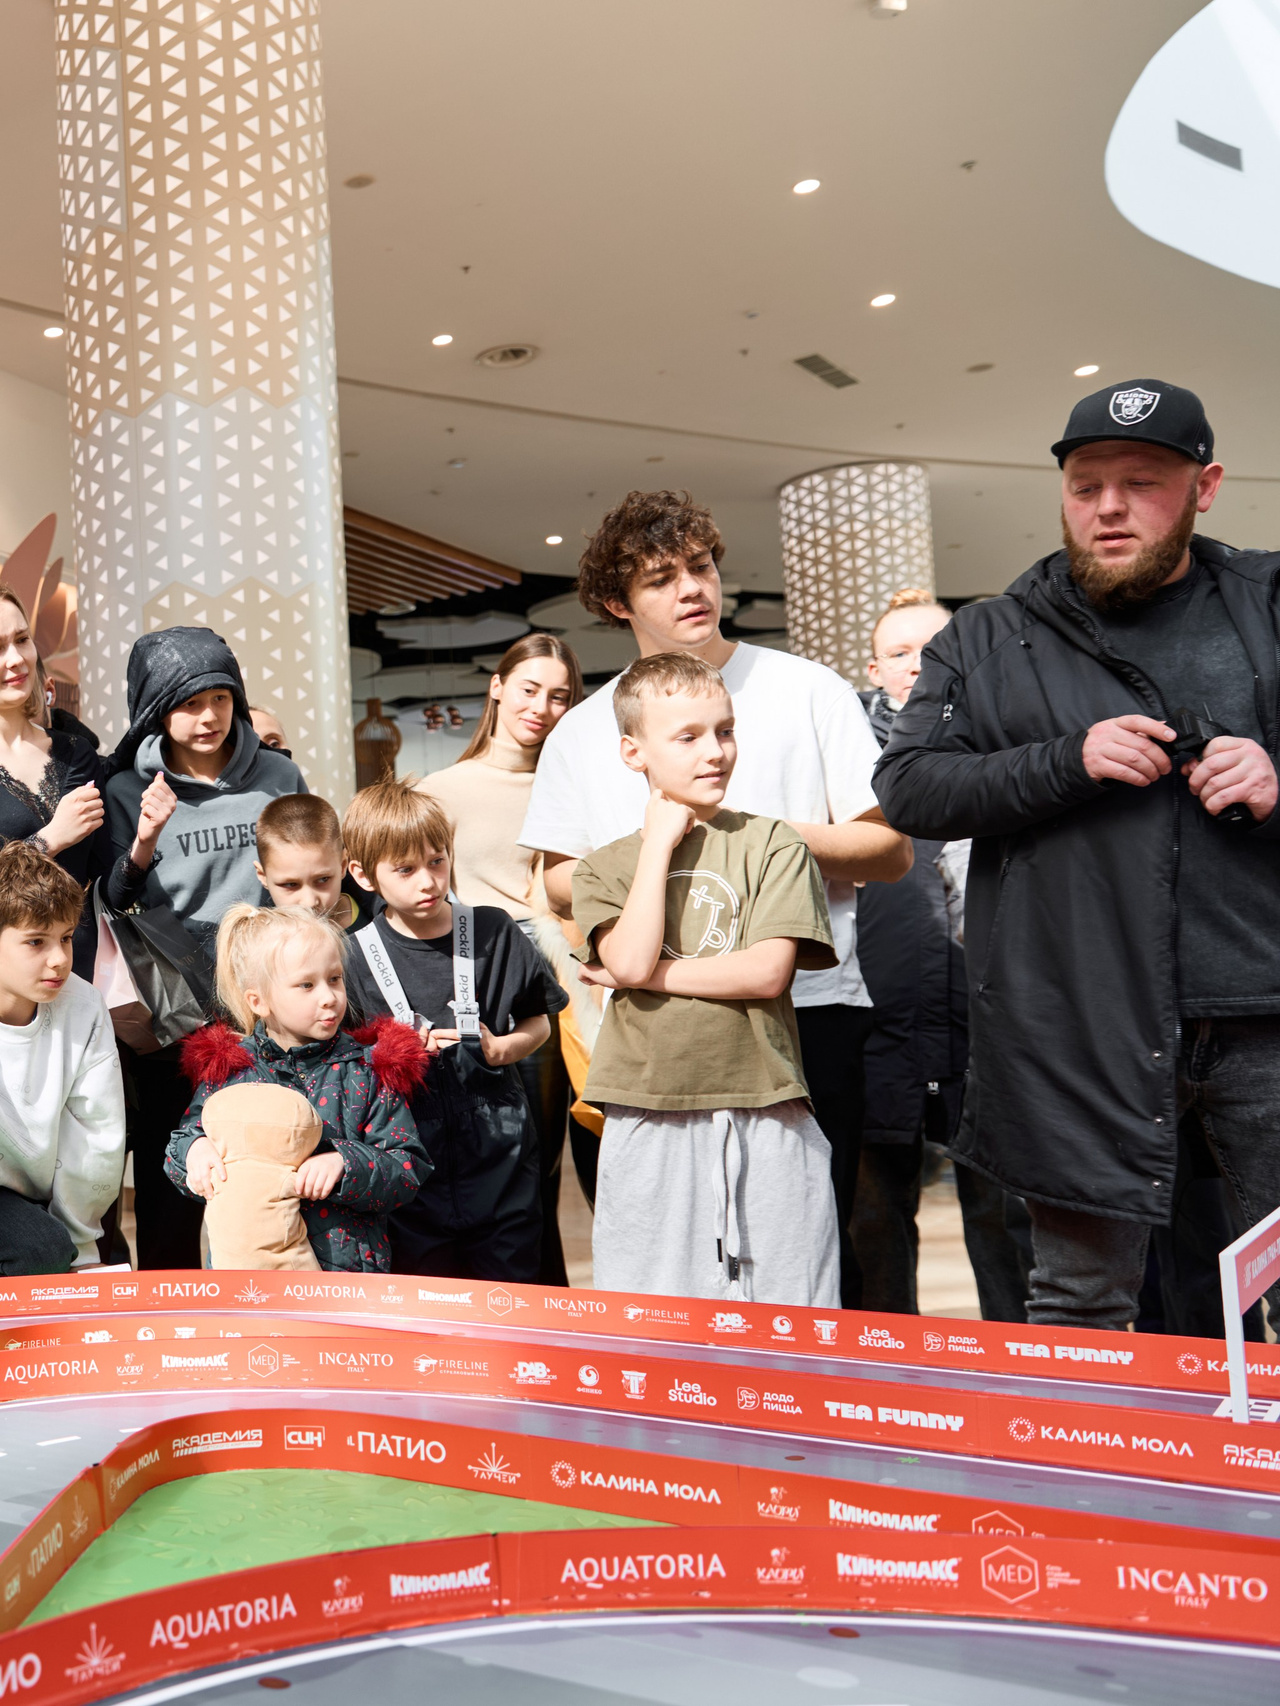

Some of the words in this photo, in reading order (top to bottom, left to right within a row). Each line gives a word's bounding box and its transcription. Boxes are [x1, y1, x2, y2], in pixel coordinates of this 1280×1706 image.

[458, 915, 470, 958] crockid
[369, 943, 395, 988] crockid
[31, 1286, 99, 1295] АКАДЕМИЯ
[159, 1283, 220, 1297] ПАТИО
[284, 1285, 366, 1300] AQUATORIA
[490, 1296, 509, 1306] MED
[544, 1298, 606, 1314] INCANTO
[645, 1309, 690, 1321] FIRELINE
[864, 1325, 890, 1338] Lee
[22, 1338, 61, 1349] FIRELINE
[858, 1335, 905, 1350] Studio
[947, 1335, 977, 1345] ДОДО
[948, 1344, 985, 1355] ПИЦЦА
[1005, 1342, 1050, 1359] TEA
[162, 1353, 228, 1368] КИНОМАКС
[251, 1355, 275, 1366] MED
[318, 1352, 393, 1367] INCANTO
[439, 1359, 488, 1371] FIRELINE
[4, 1359, 99, 1384] AQUATORIA
[1207, 1360, 1280, 1376] КАИНА
[674, 1378, 701, 1393] Lee
[668, 1388, 717, 1407] Studio
[762, 1392, 794, 1403] ДОДО
[763, 1402, 803, 1414] ПИЦЦА
[824, 1401, 873, 1421] TEA
[172, 1429, 262, 1449] АКАДЕМИЯ
[358, 1431, 446, 1463] ПАТИО
[1041, 1425, 1125, 1448] КАЛИНА
[1132, 1436, 1194, 1457] МОЛЛ
[116, 1461, 137, 1489] КАЛИНА
[139, 1449, 160, 1469] МОЛЛ
[581, 1471, 658, 1496] КАЛИНА
[664, 1482, 721, 1505] МОЛЛ
[828, 1498, 937, 1532] КИНОМАКС
[31, 1522, 63, 1578] ПАТИО
[561, 1554, 726, 1589] AQUATORIA
[836, 1552, 959, 1582] КИНОМАКС
[988, 1564, 1033, 1584] MED
[390, 1562, 490, 1597] КИНОМАКС
[1117, 1565, 1268, 1603] INCANTO
[1174, 1595, 1210, 1609] ITALY
[150, 1593, 297, 1648] AQUATORIA
